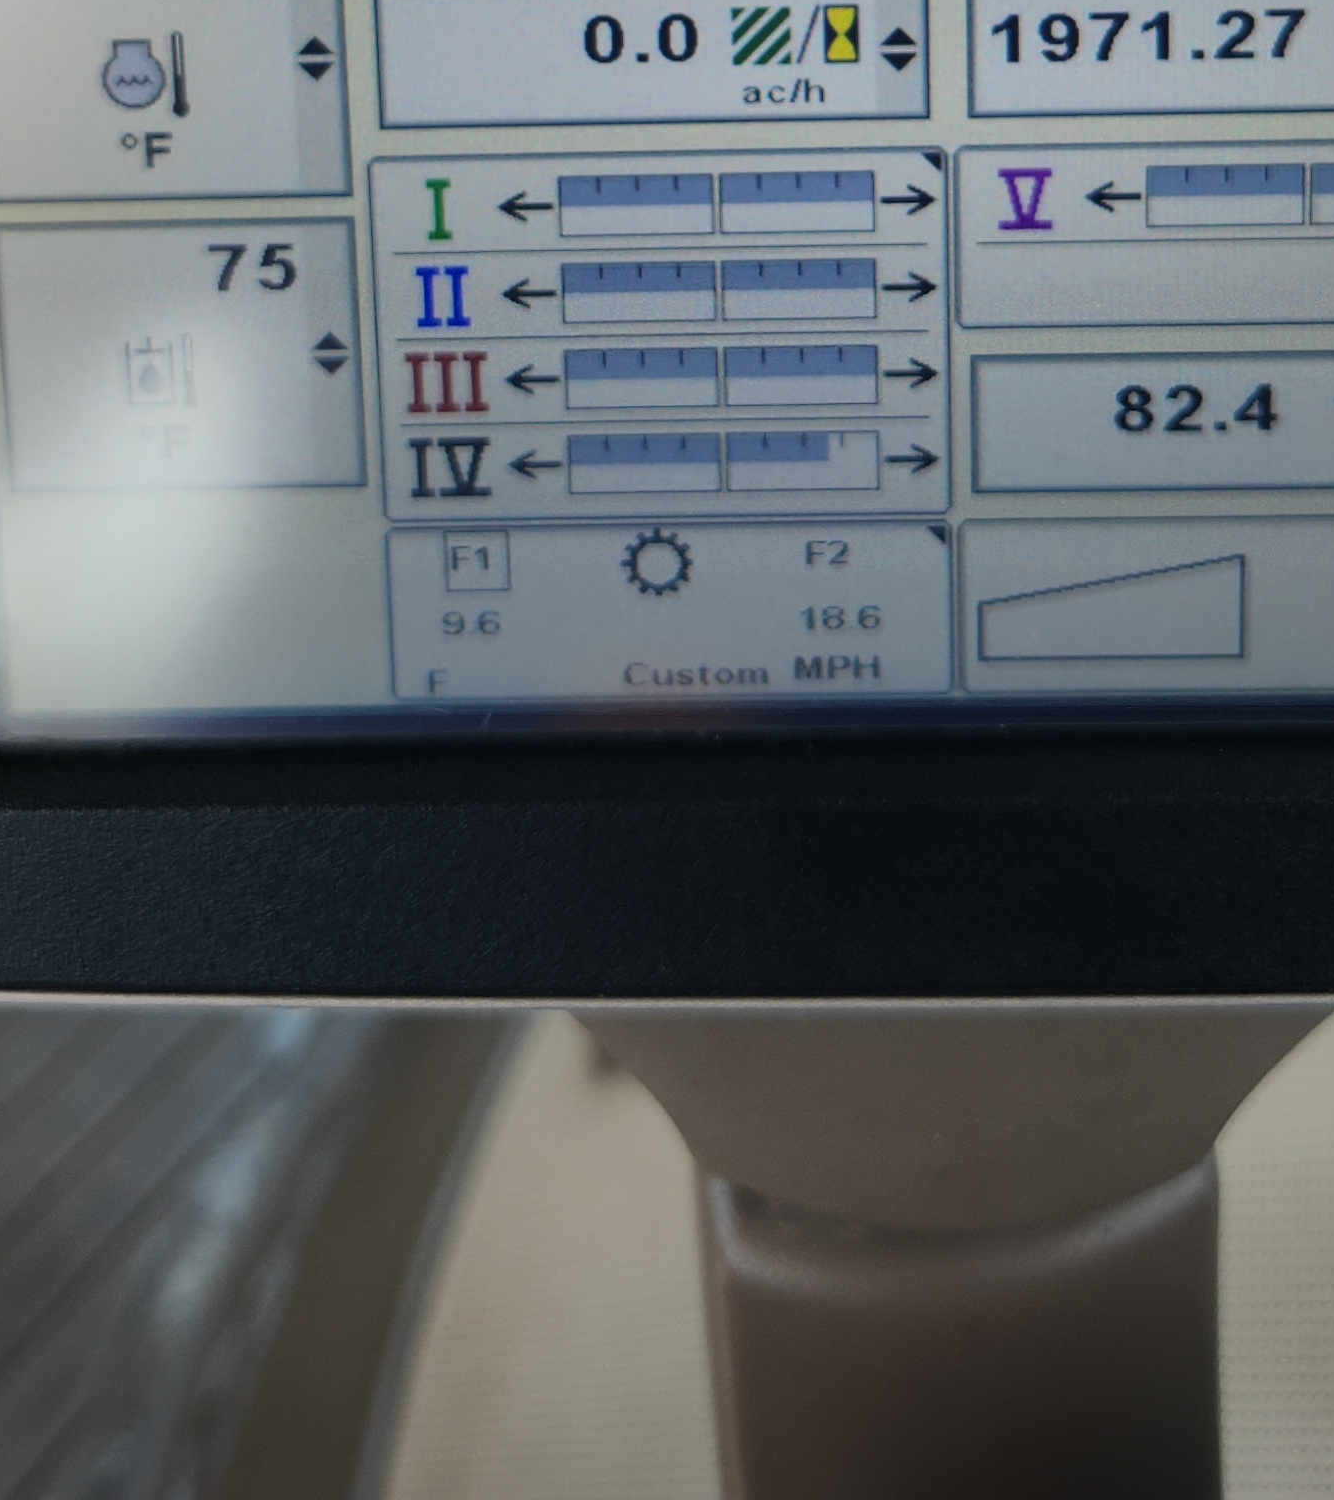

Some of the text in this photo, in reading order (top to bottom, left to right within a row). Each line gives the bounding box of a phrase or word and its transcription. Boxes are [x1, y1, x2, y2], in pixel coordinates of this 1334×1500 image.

[584, 13, 698, 64] 0.0
[990, 8, 1306, 63] 1971.27
[742, 79, 825, 105] ac/h
[122, 133, 172, 168] °F
[425, 178, 452, 240] I
[997, 167, 1053, 231] V
[208, 243, 297, 292] 75
[415, 266, 471, 327] II
[404, 351, 490, 413] III
[1113, 384, 1278, 434] 82.4
[408, 437, 493, 498] IV
[450, 546, 491, 571] F1
[805, 540, 850, 566] F2
[442, 611, 501, 636] 9.6
[800, 605, 881, 631] 18.6
[624, 655, 881, 688] Custom MPH
